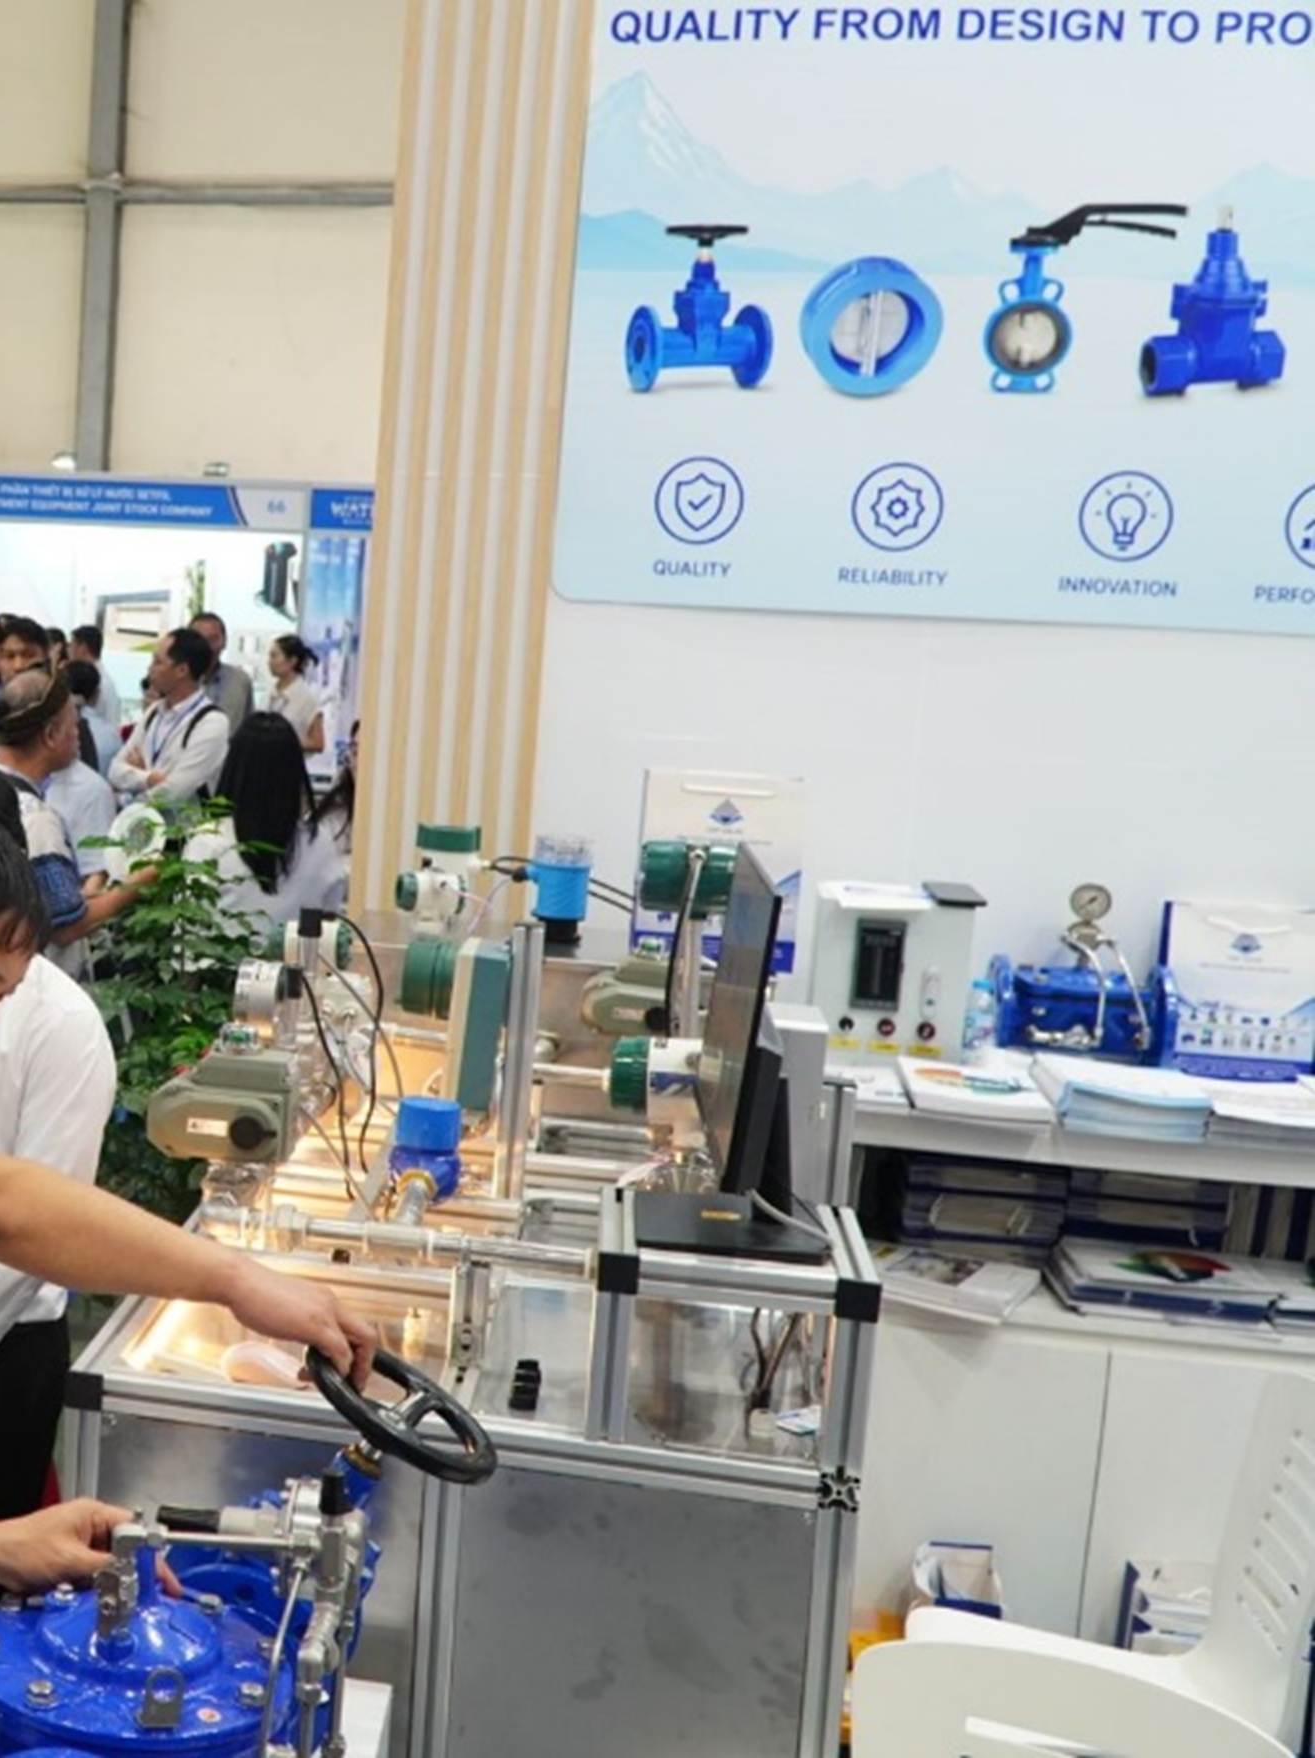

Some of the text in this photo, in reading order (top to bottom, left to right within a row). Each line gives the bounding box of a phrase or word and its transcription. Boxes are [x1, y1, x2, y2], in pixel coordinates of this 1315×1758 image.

[611, 9, 1314, 46] QUALITY FROM DESIGN TO PRO
[652, 559, 732, 578] QUALITY
[838, 567, 948, 586] RELIABILITY
[1057, 576, 1178, 598] INNOVATION
